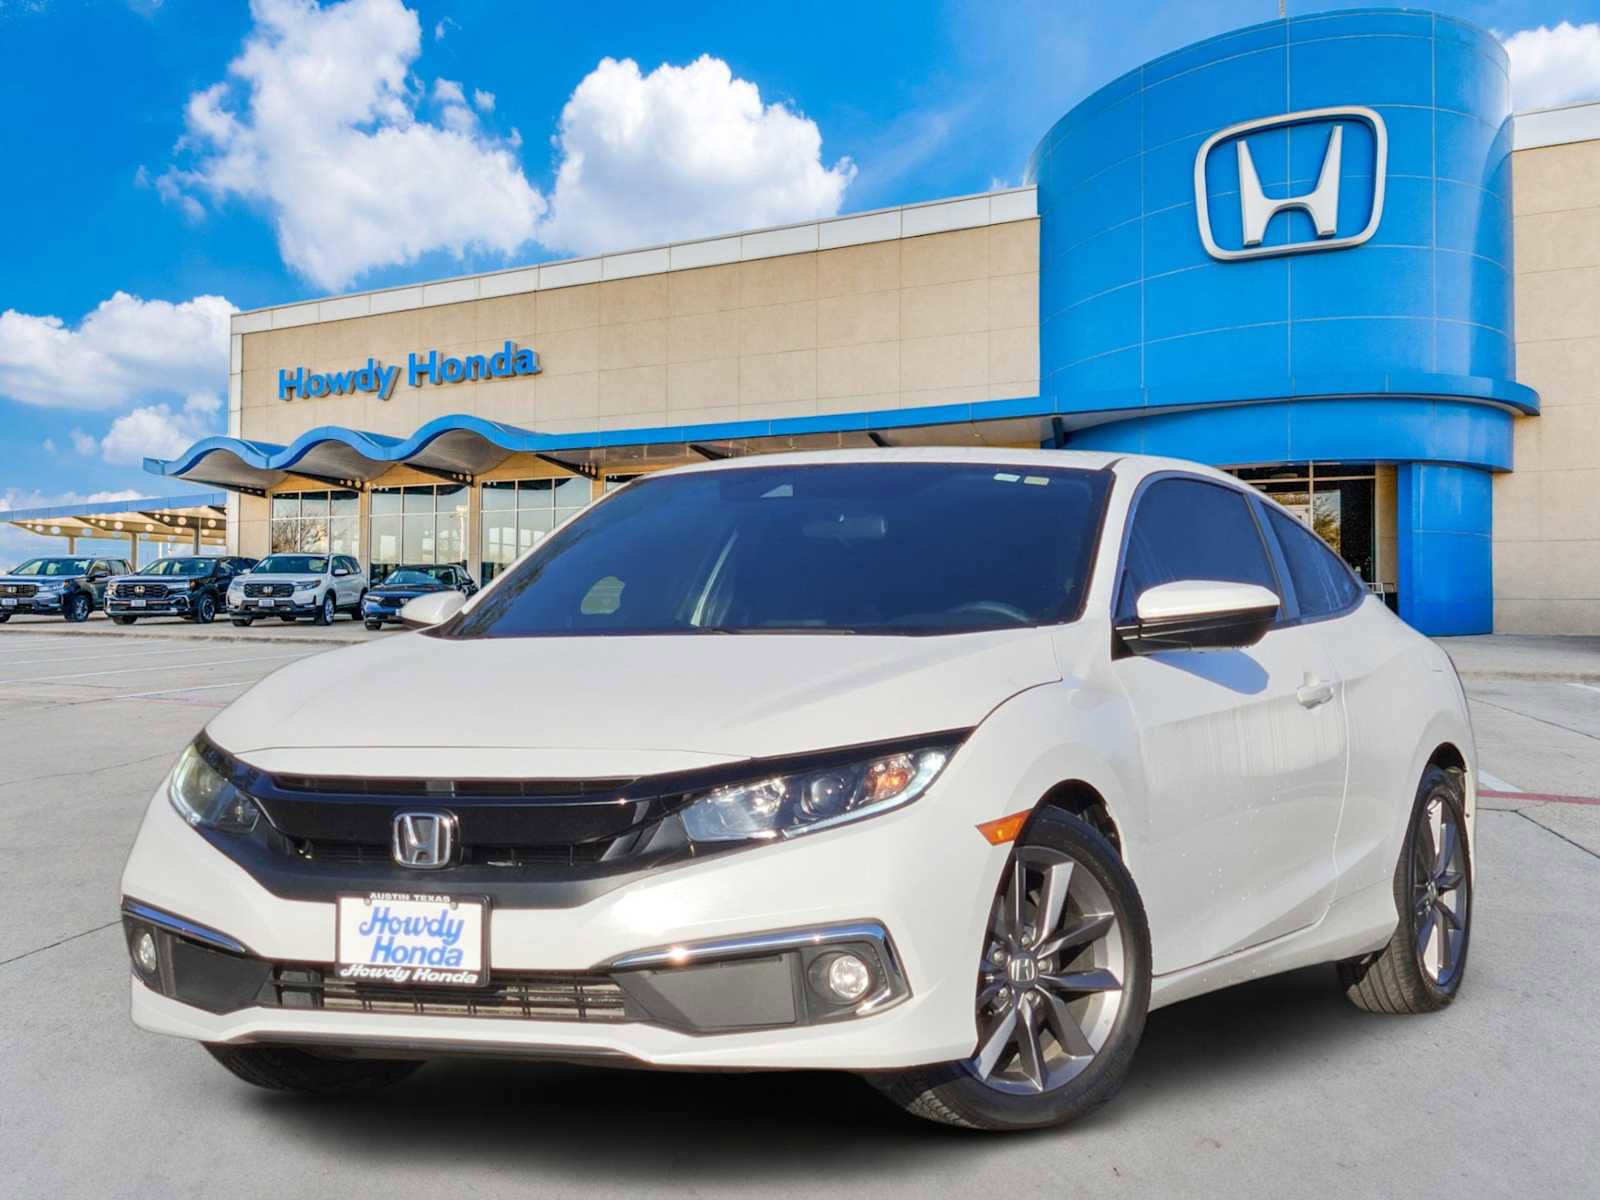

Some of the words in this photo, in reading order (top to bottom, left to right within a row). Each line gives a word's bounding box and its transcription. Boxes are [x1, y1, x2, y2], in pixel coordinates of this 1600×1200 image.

[278, 358, 401, 400] Howdy
[407, 340, 542, 387] Honda
[369, 892, 410, 901] AUSTIN
[413, 894, 451, 903] TEXAS
[358, 906, 465, 946] Howdy
[369, 936, 464, 967] Honda
[339, 963, 412, 983] Howdy
[411, 967, 479, 985] Honda
